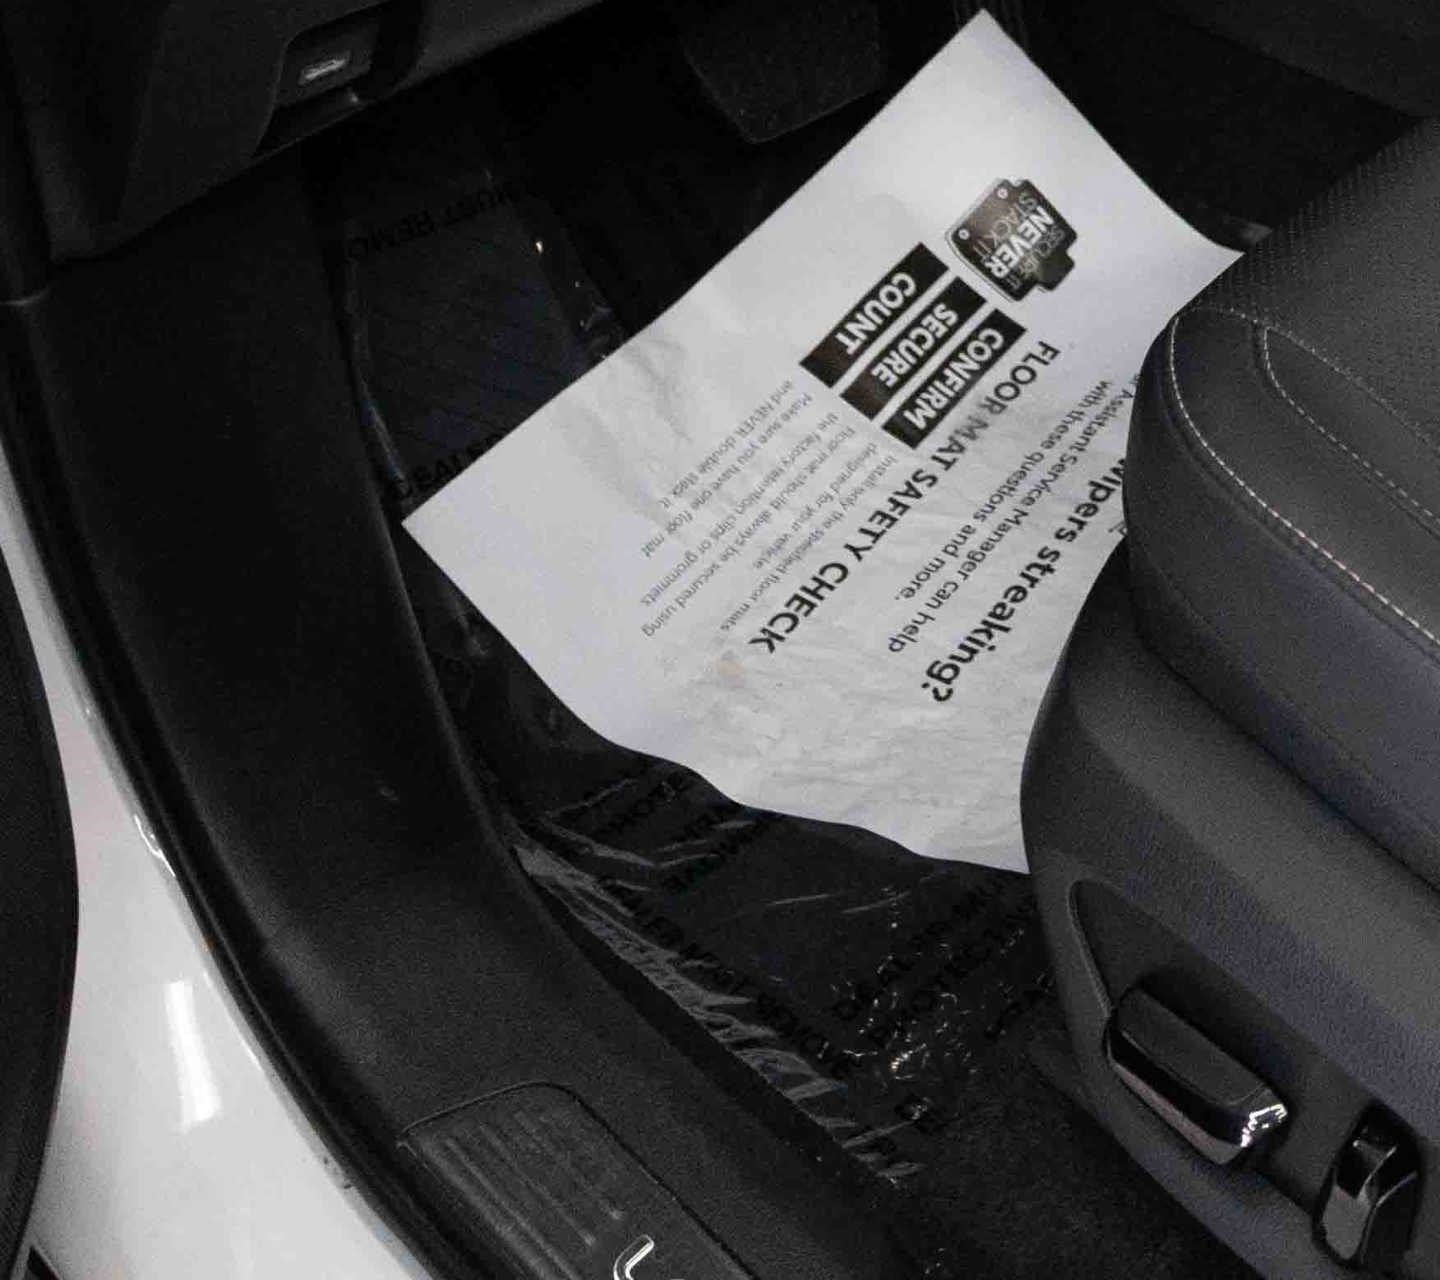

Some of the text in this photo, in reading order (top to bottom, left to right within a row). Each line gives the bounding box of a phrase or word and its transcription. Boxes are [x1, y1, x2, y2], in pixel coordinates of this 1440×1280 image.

[972, 192, 1037, 262] STACK IT
[984, 205, 1054, 278] NEVER
[835, 273, 916, 355] COUNT
[870, 303, 958, 387] SECURE
[903, 328, 1004, 429] CONFIRM
[1068, 388, 1134, 453] Assistant
[748, 340, 1061, 654] FLOOR MAT SAFETY CHECK
[895, 380, 1111, 601] with these questions and more.
[1020, 453, 1078, 507] Service
[956, 508, 1029, 582] Manager
[888, 611, 936, 653] help
[921, 543, 1064, 703] streaking?
[924, 580, 960, 610] can
